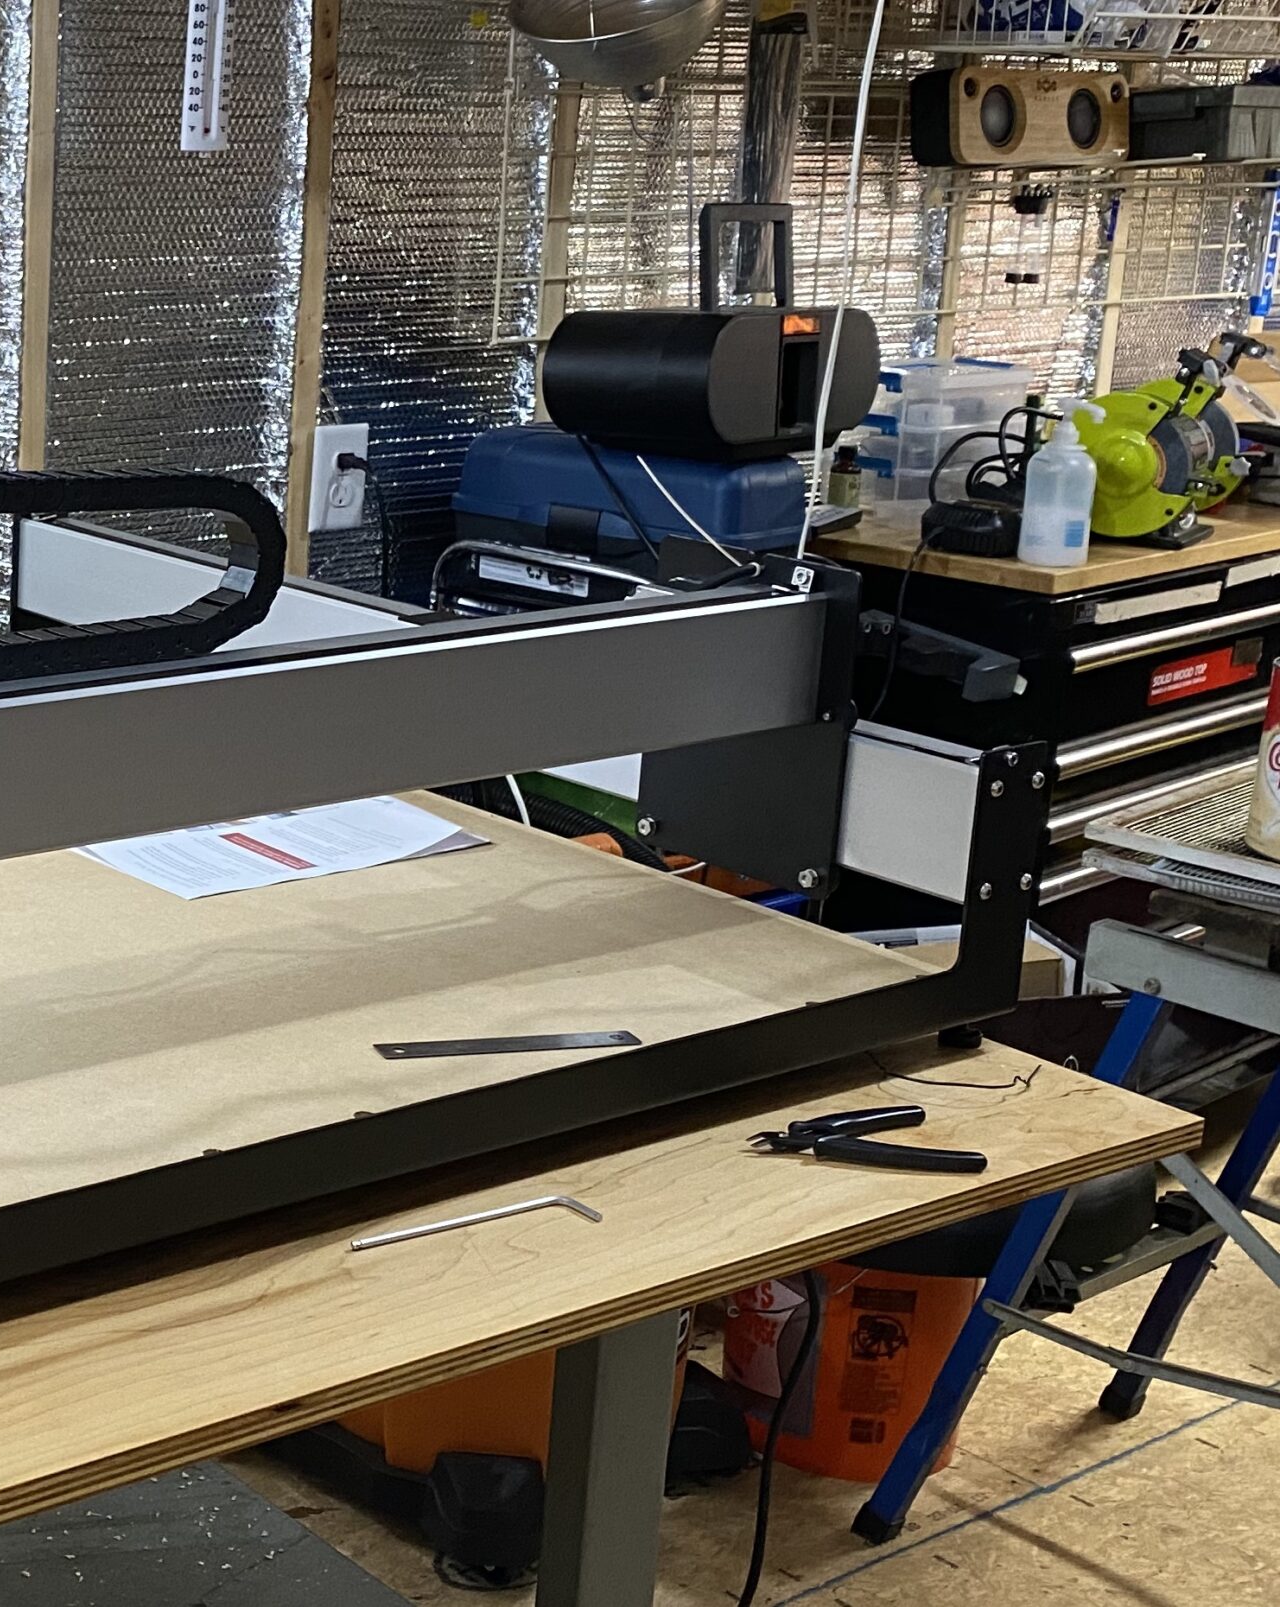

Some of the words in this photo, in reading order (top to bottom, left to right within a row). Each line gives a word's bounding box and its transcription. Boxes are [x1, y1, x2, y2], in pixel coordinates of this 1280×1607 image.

[194, 3, 206, 12] 80
[193, 20, 204, 29] 60
[192, 37, 203, 45] 40
[191, 53, 202, 62] 20
[192, 70, 199, 79] 0
[189, 86, 201, 95] 20
[188, 103, 199, 112] 40
[1152, 673, 1173, 687] SOLID
[1173, 666, 1194, 681] WOOD
[1194, 662, 1208, 676] TOP
